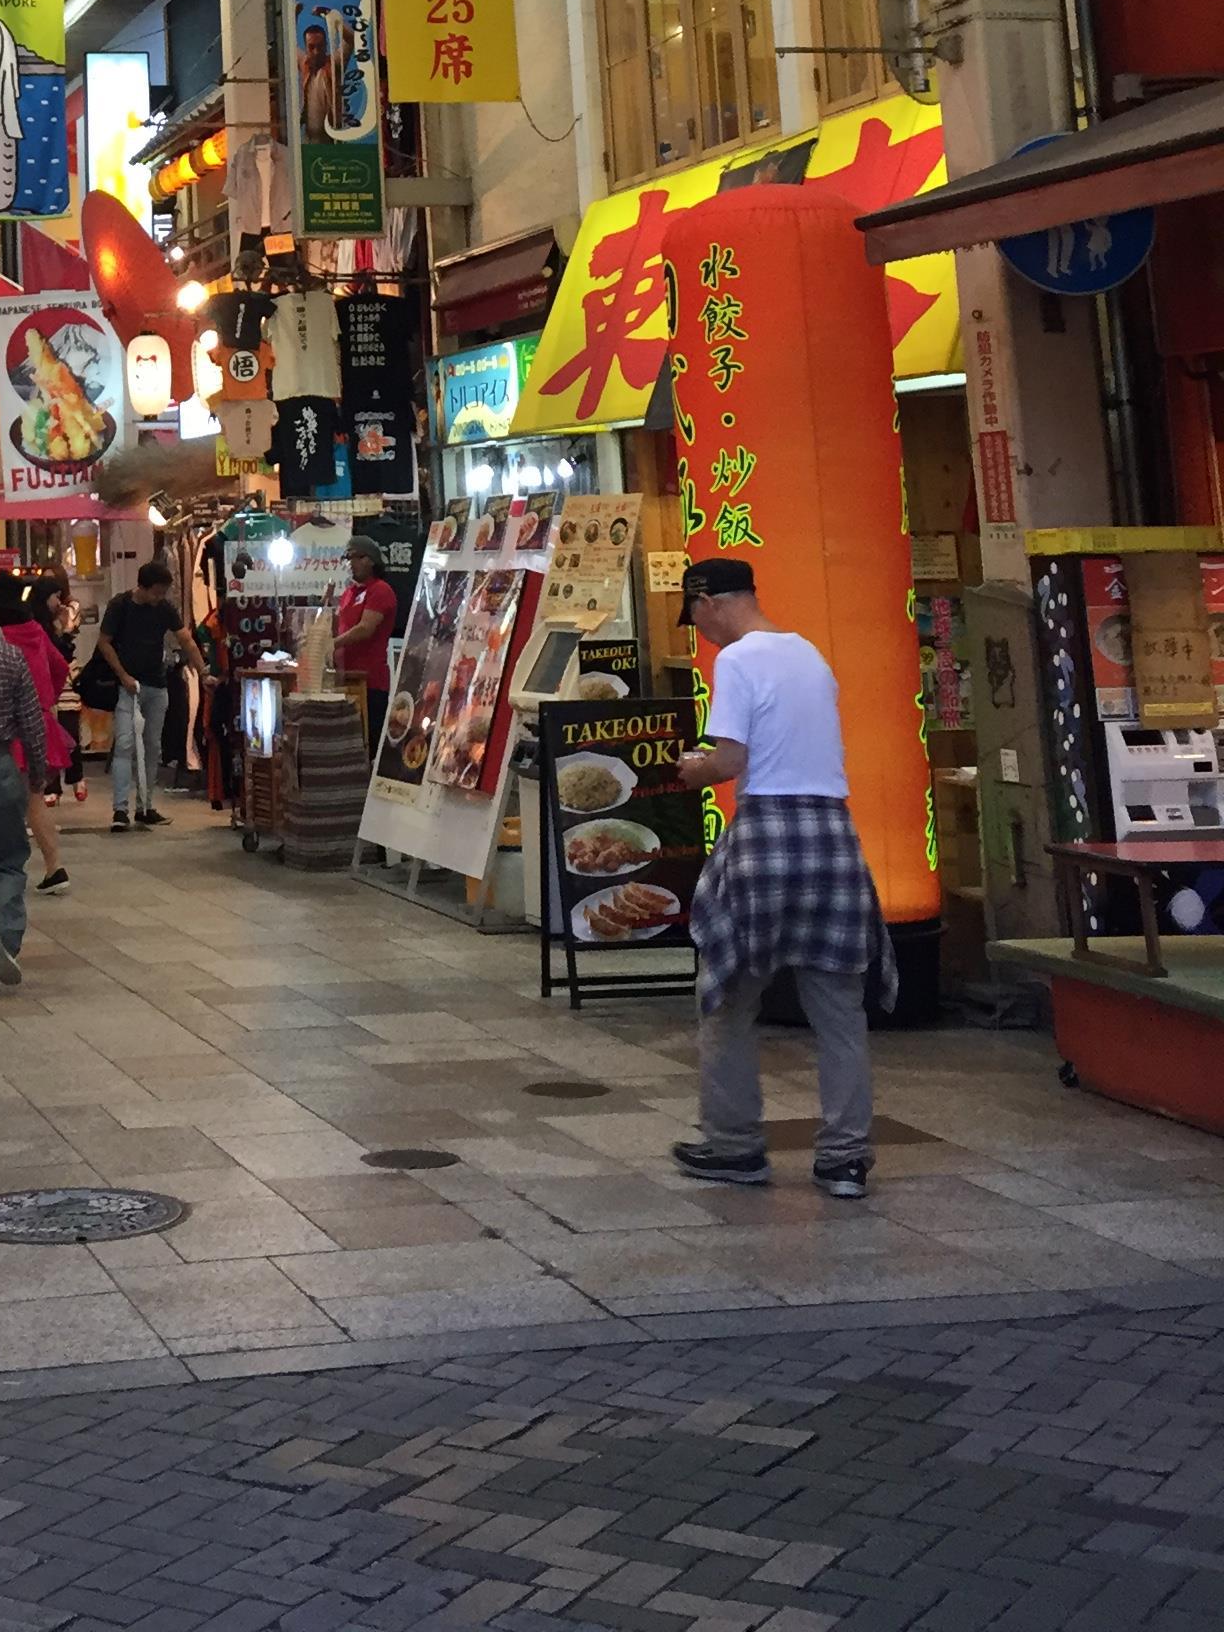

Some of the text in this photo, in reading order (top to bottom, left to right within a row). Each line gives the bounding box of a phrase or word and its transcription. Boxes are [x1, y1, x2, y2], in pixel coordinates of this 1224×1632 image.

[430, 32, 475, 86] 席
[233, 355, 254, 377] 悟
[450, 380, 510, 412] トルコアイス
[698, 243, 764, 549] 水餃子・炒飯
[581, 644, 634, 660] TAKEOUT
[611, 657, 638, 672] OK!
[562, 712, 678, 745] TAKEOUT
[632, 738, 687, 769] OK!
